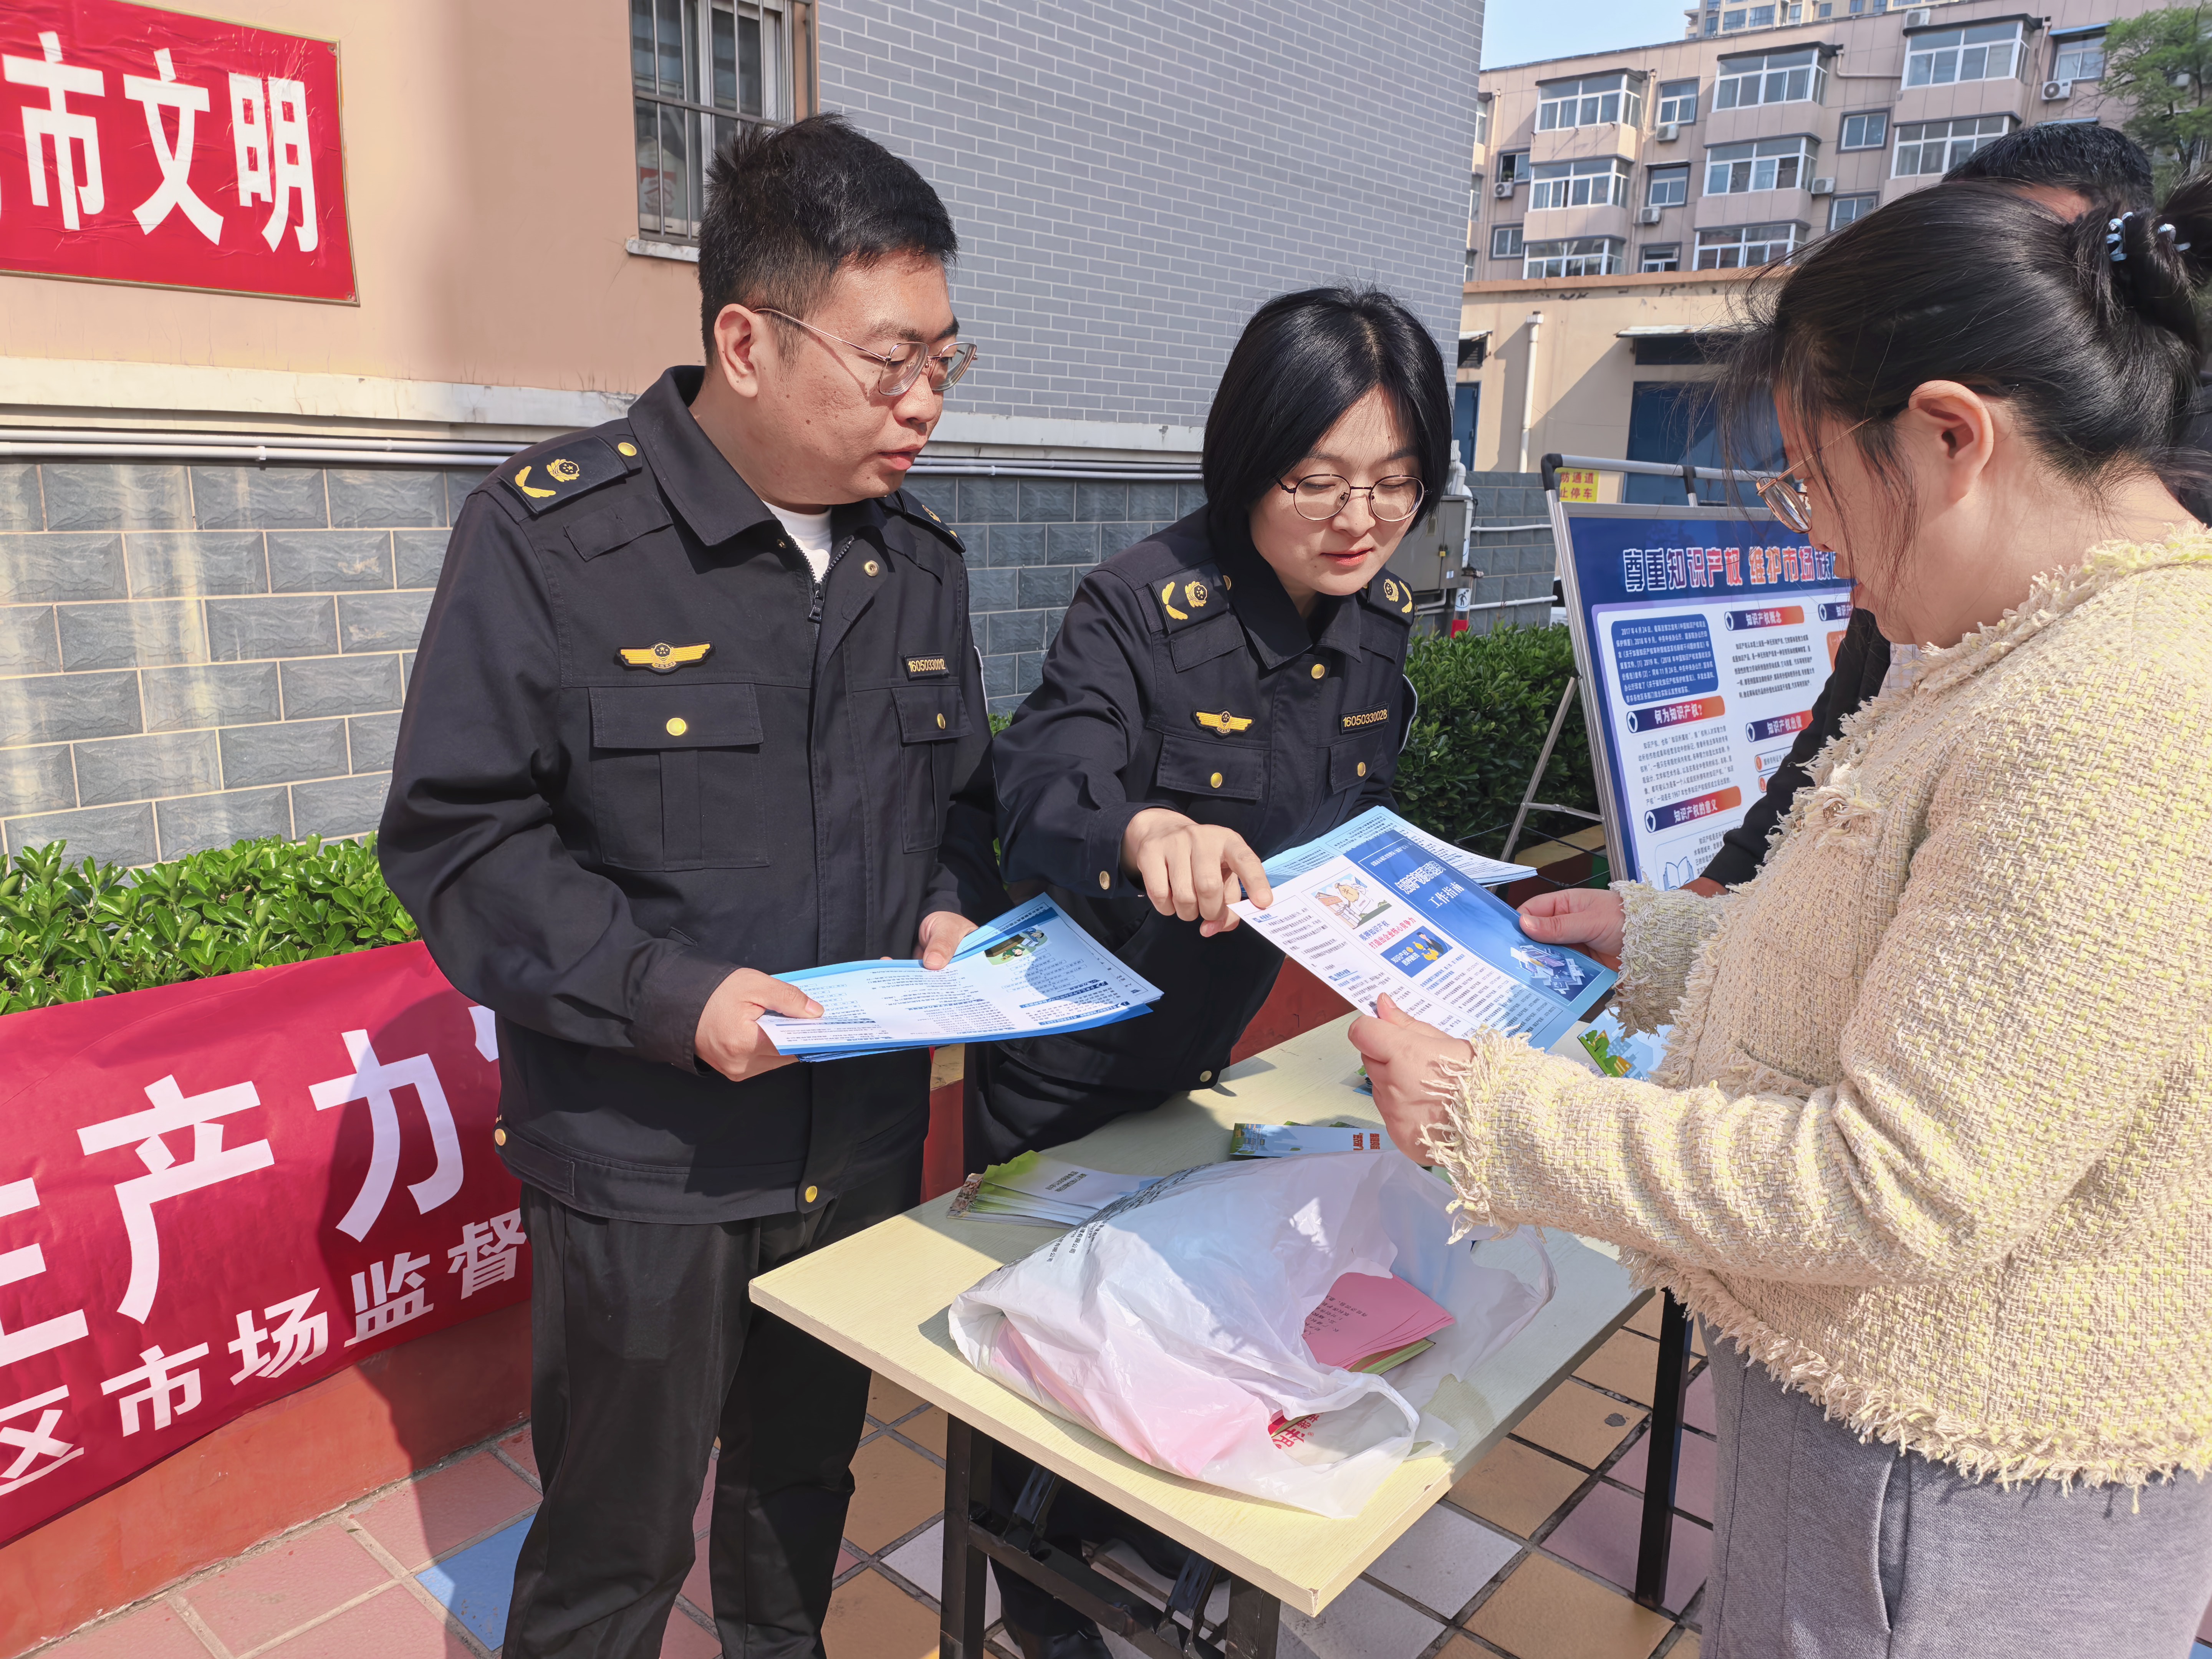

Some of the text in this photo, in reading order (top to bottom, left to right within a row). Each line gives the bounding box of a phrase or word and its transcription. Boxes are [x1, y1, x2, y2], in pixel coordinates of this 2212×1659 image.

[2, 31, 318, 253] 市文明
[1560, 487, 1593, 500] 止停车
[1623, 547, 1742, 592] 尊重知识产权
[1745, 610, 1782, 627] 知识产权概念
[908, 658, 946, 672] 16050330012
[1343, 709, 1387, 727] 16050330028
[1654, 703, 1702, 724] 何为知识产权?
[1674, 799, 1718, 823] 知识产权的意义
[1428, 882, 1465, 909] 工作指南
[1359, 920, 1390, 941] 质押知识产权
[1368, 917, 1416, 949] 打造出企业核心竞争力
[1390, 949, 1410, 964] 知识产权
[0, 1005, 499, 1368] 产力
[0, 1208, 527, 1496] 区市场监督
